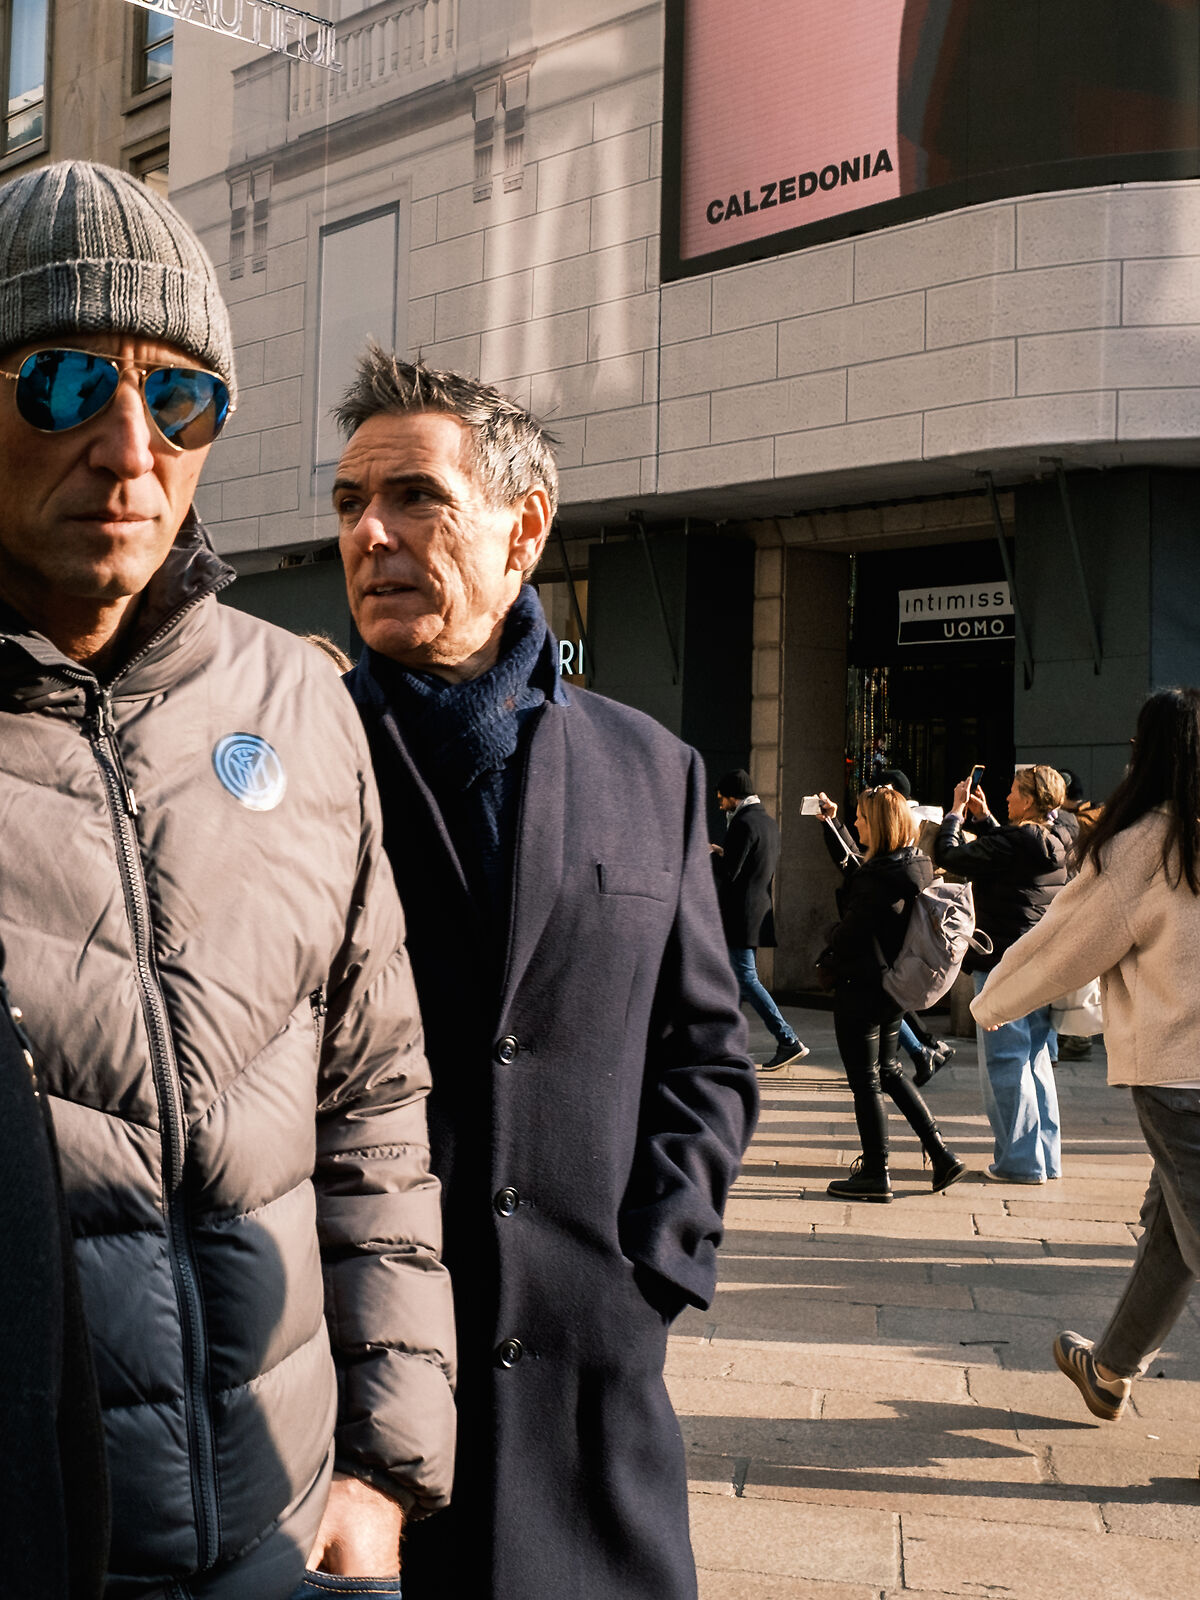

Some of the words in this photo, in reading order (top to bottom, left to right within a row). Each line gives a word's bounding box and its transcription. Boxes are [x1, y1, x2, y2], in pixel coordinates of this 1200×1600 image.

[141, 0, 342, 70] AUTIFUL
[706, 149, 893, 225] CALZEDONIA
[943, 619, 1005, 637] UOMO
